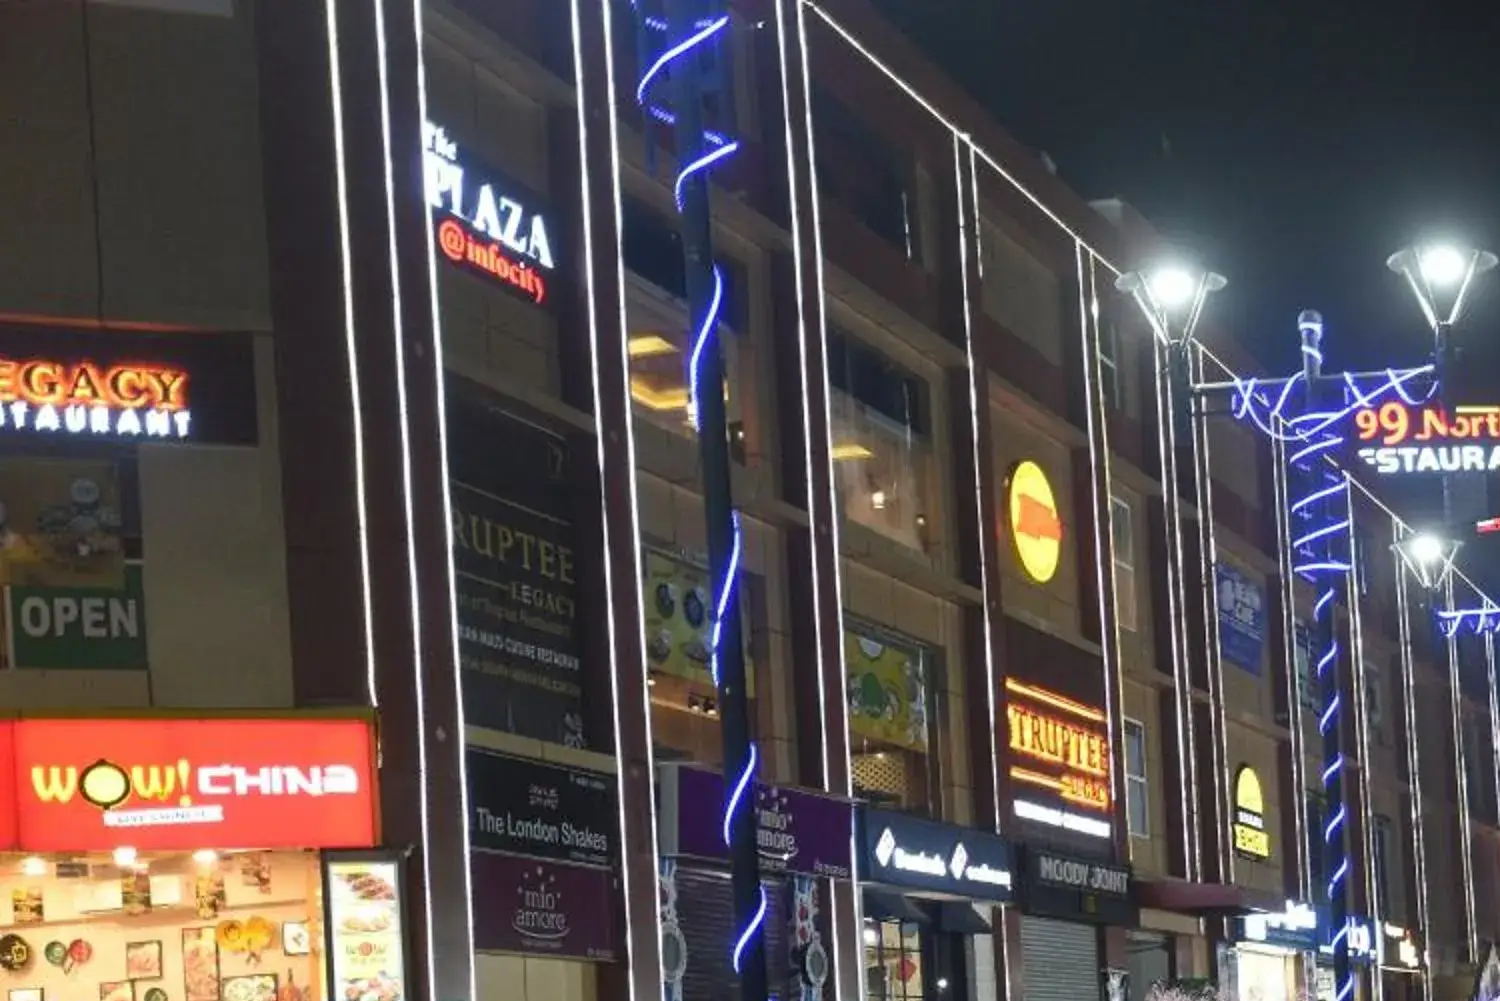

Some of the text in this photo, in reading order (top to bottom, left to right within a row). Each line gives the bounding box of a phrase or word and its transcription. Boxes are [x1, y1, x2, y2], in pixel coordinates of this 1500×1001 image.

[425, 153, 554, 269] PLAZA
[439, 219, 544, 304] @infocity
[0, 400, 191, 437] TAURANT
[1355, 402, 1408, 445] 99
[20, 596, 138, 638] OPEN
[1006, 702, 1108, 778] TRUPTEE
[31, 758, 358, 809] WOW! CHINA
[476, 807, 608, 851] The London Shakes
[524, 883, 556, 909] mio
[1039, 855, 1089, 886] MOODY
[1091, 863, 1129, 894] JOINT
[516, 909, 566, 930] amore
